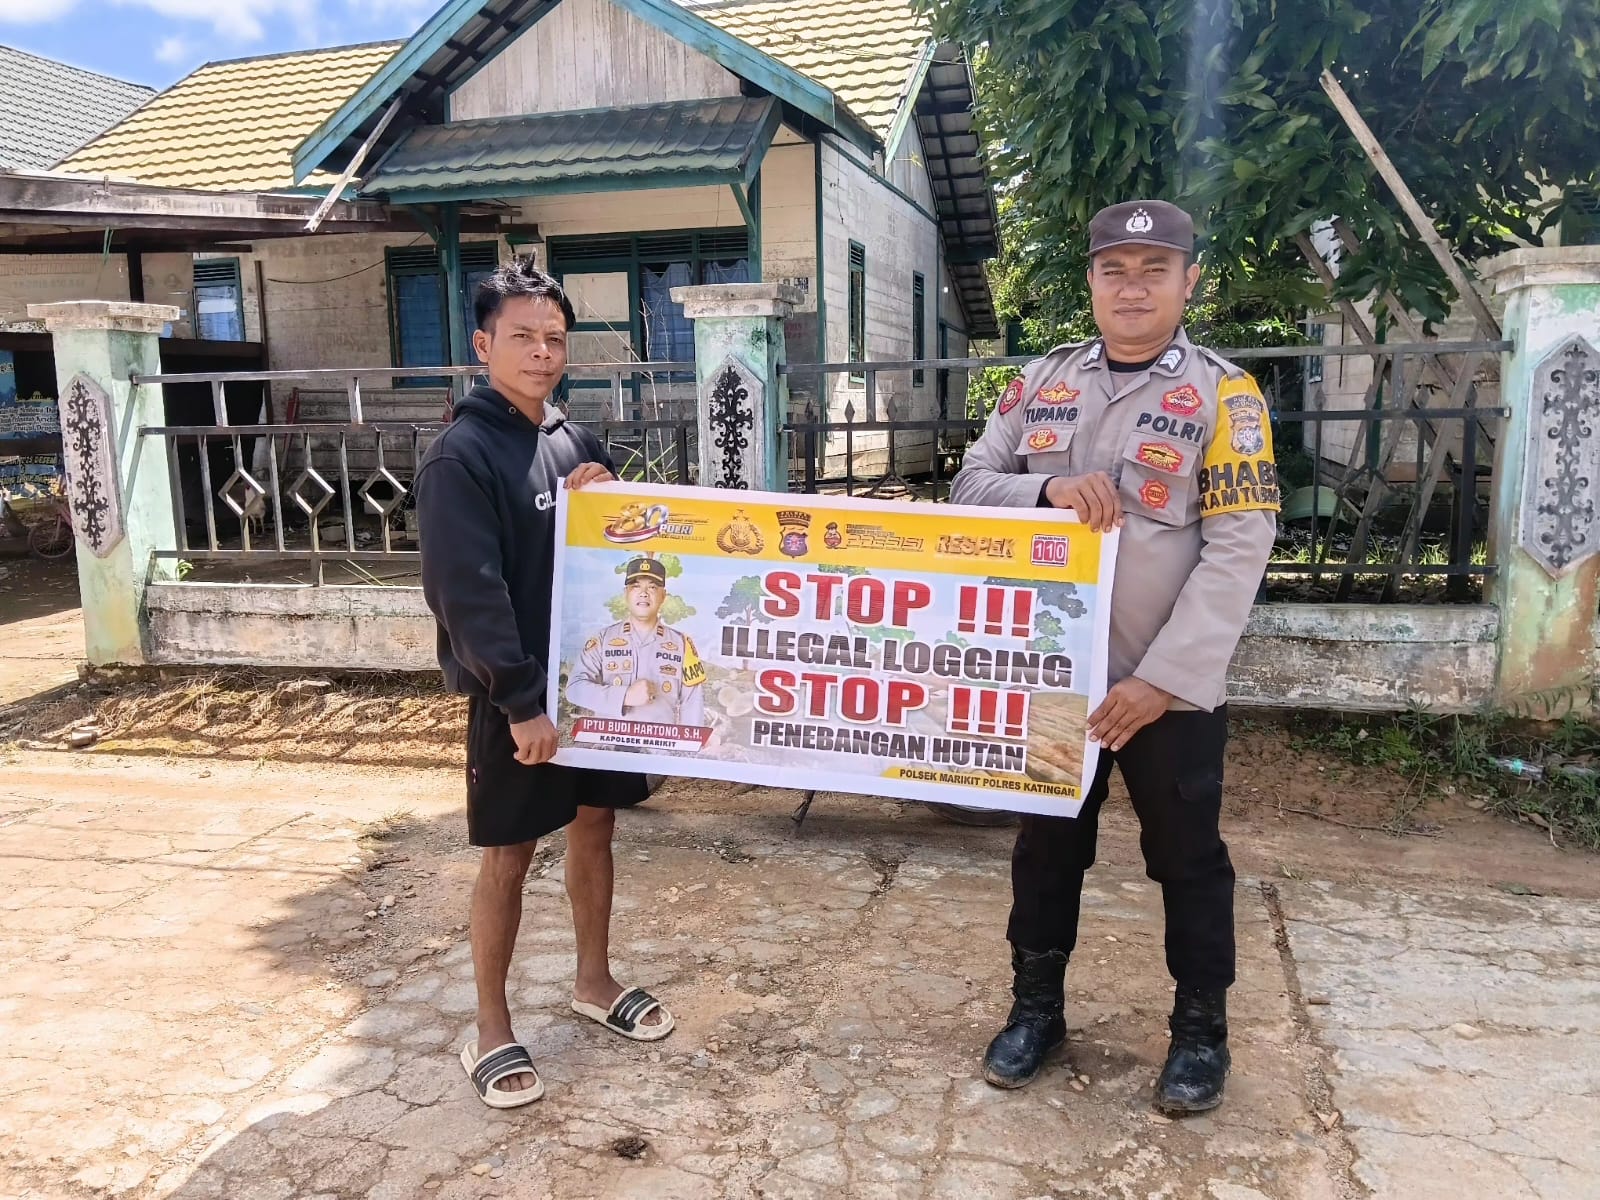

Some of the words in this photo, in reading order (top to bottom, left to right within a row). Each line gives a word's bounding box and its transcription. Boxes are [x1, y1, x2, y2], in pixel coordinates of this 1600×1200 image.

[1025, 406, 1078, 424] TUPANG
[1136, 412, 1204, 443] POLRI
[658, 523, 694, 535] POLRI
[935, 534, 1015, 559] RESPEK
[1034, 541, 1066, 560] 110
[763, 570, 931, 627] STOP
[957, 584, 1036, 638] !!!
[655, 652, 682, 663] POLRI
[720, 626, 873, 669] ILLEGAL
[883, 639, 1074, 689] LOGGING
[758, 669, 926, 725] STOP
[951, 686, 1027, 738] !!!
[583, 719, 606, 731] IPTU
[607, 721, 631, 734] BUDI
[633, 724, 681, 739] HARTONO,
[683, 727, 703, 740] S.H.
[599, 735, 641, 745] KAPOLSEK
[642, 738, 677, 748] MARIKIT
[752, 720, 926, 761] PENEBANGAN
[932, 738, 1025, 772] HUTAN
[899, 768, 938, 782] POLSEK
[939, 773, 981, 787] MARIKIT
[982, 778, 1022, 791] POLRES
[1023, 782, 1076, 797] KATINGAN
